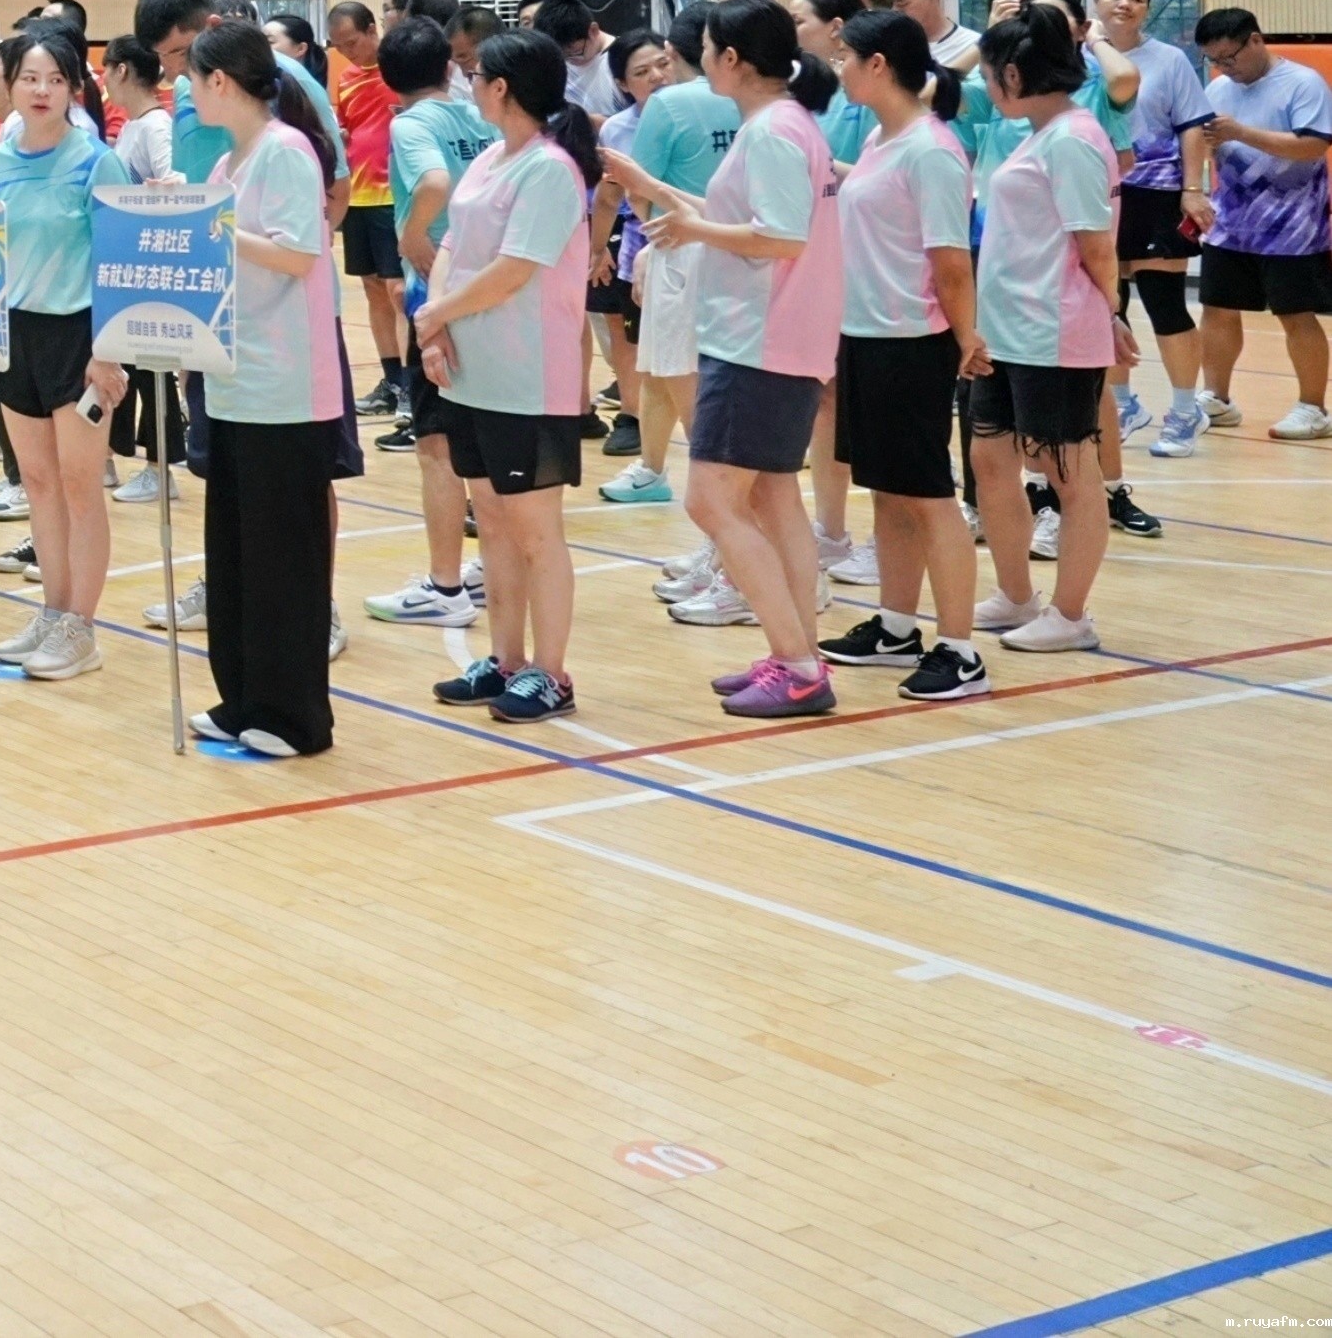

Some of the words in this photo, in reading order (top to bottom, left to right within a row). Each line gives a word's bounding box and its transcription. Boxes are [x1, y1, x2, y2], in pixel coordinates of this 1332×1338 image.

[138, 227, 193, 254] 井湘社区
[96, 262, 227, 294] 新就业形态联合工会队
[126, 319, 158, 338] 超越自我
[161, 322, 194, 340] 秀出风采
